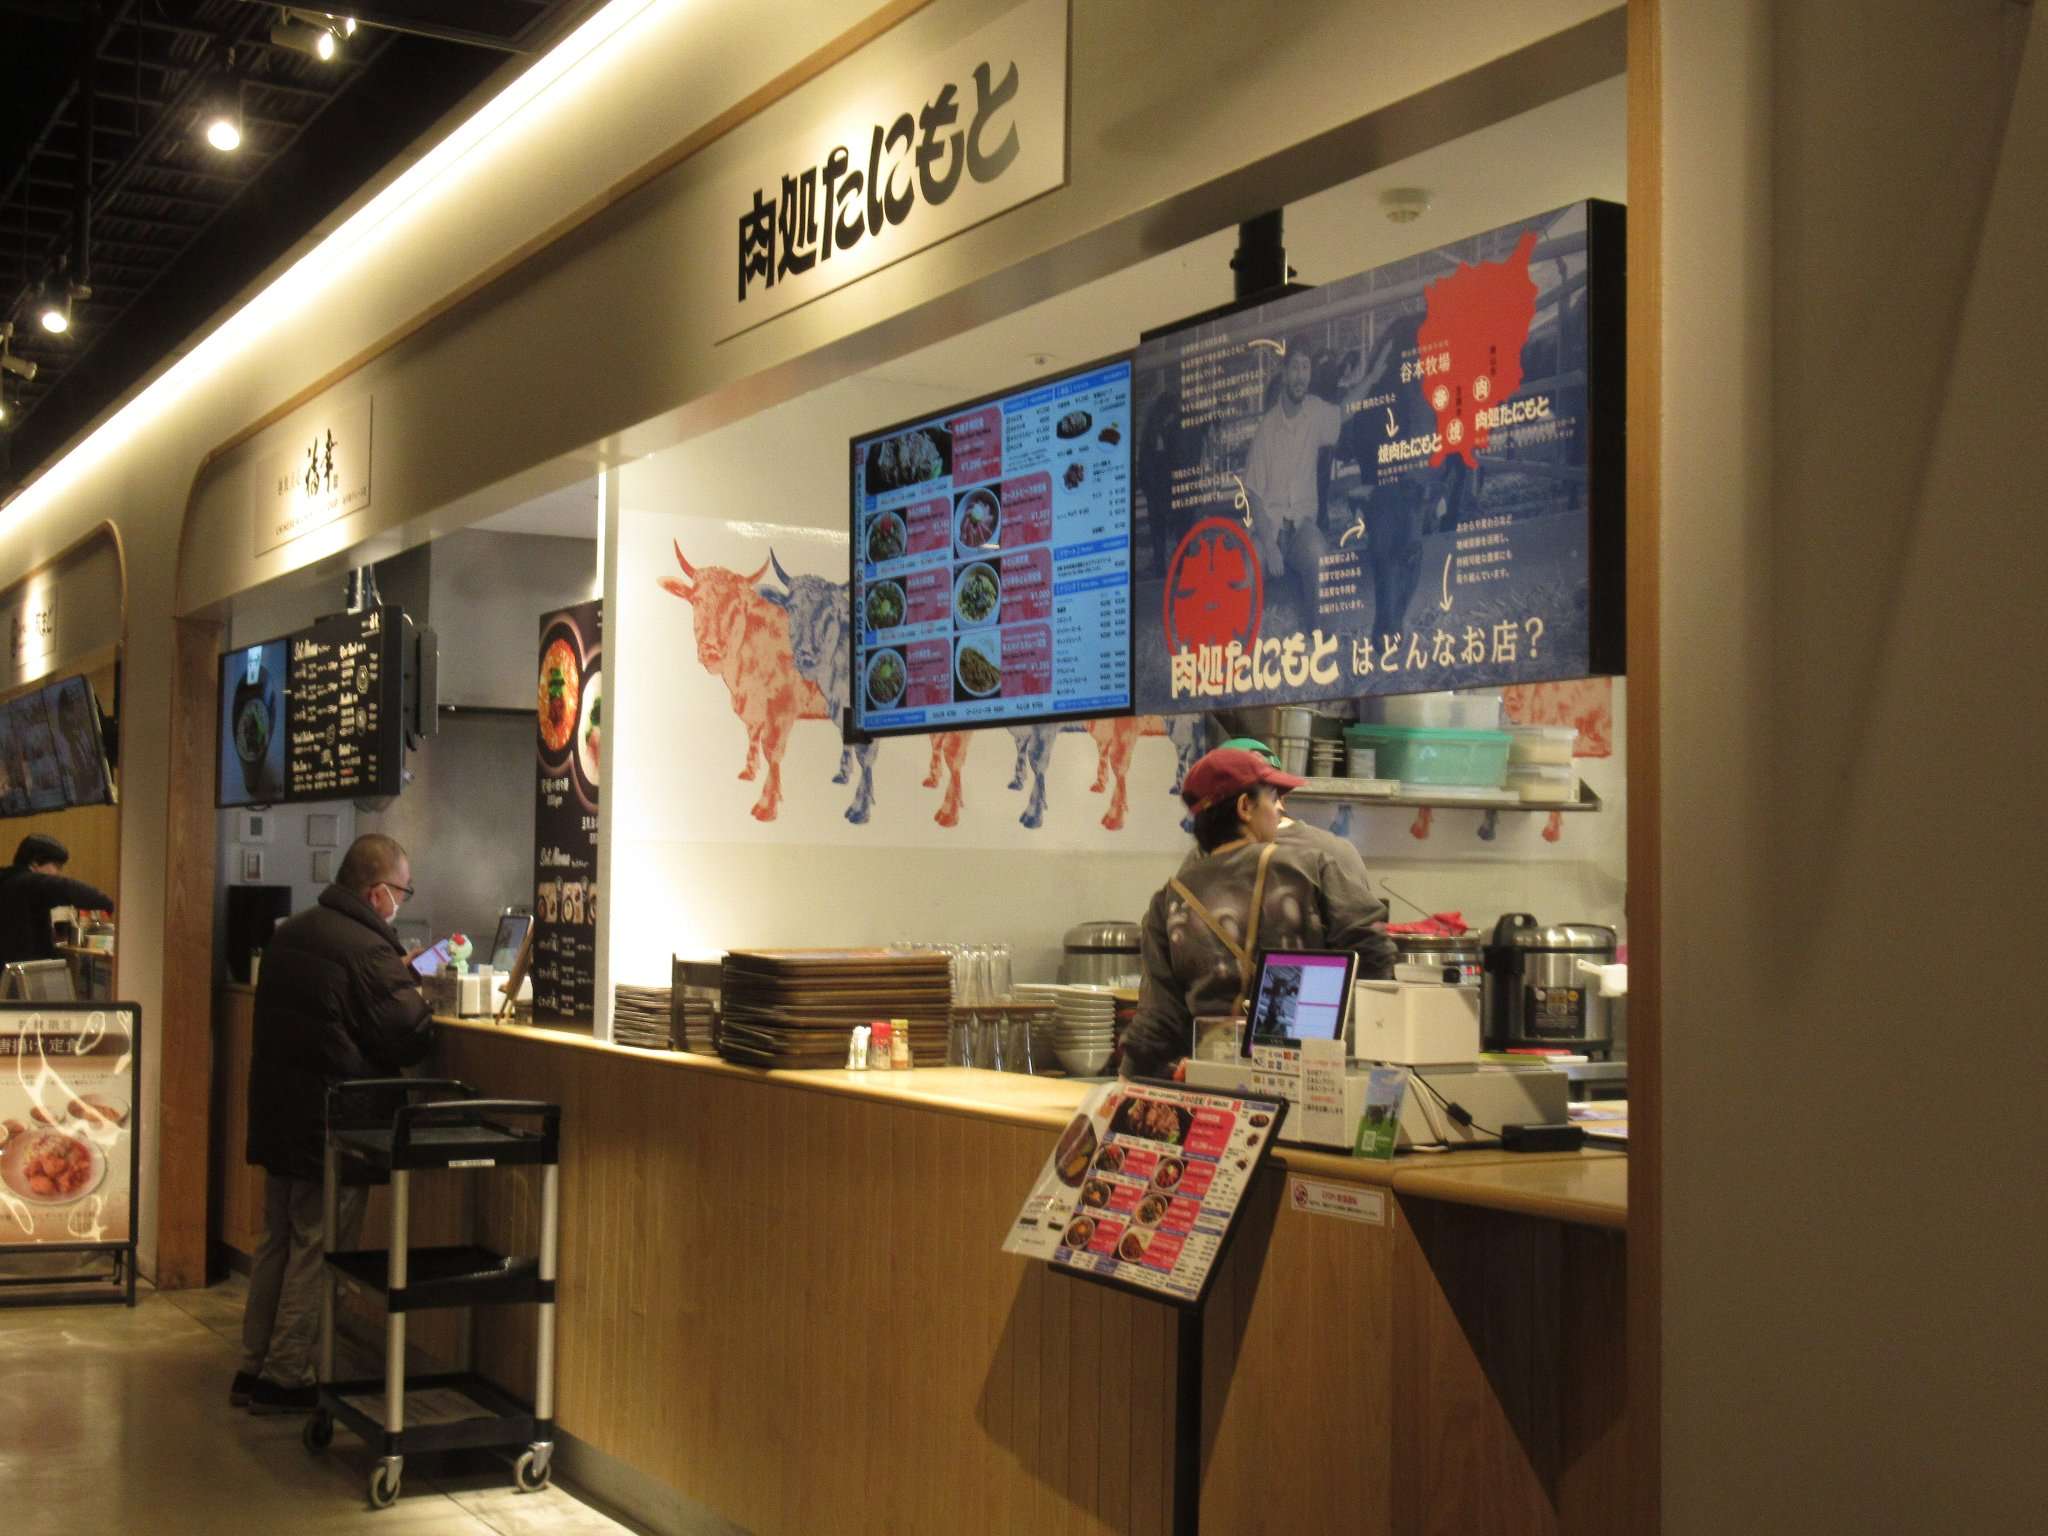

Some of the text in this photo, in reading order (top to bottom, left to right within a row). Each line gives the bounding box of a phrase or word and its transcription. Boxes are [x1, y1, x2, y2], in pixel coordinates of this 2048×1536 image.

[738, 60, 1020, 303] 肉処たにもと
[1400, 352, 1451, 384] 谷本牧場
[1475, 396, 1551, 432] 肉処たにもと
[1378, 433, 1443, 465] 焼肉たにもと
[1171, 629, 1340, 699] 肉処たにもと
[1352, 617, 1544, 676] はどんなお店？
